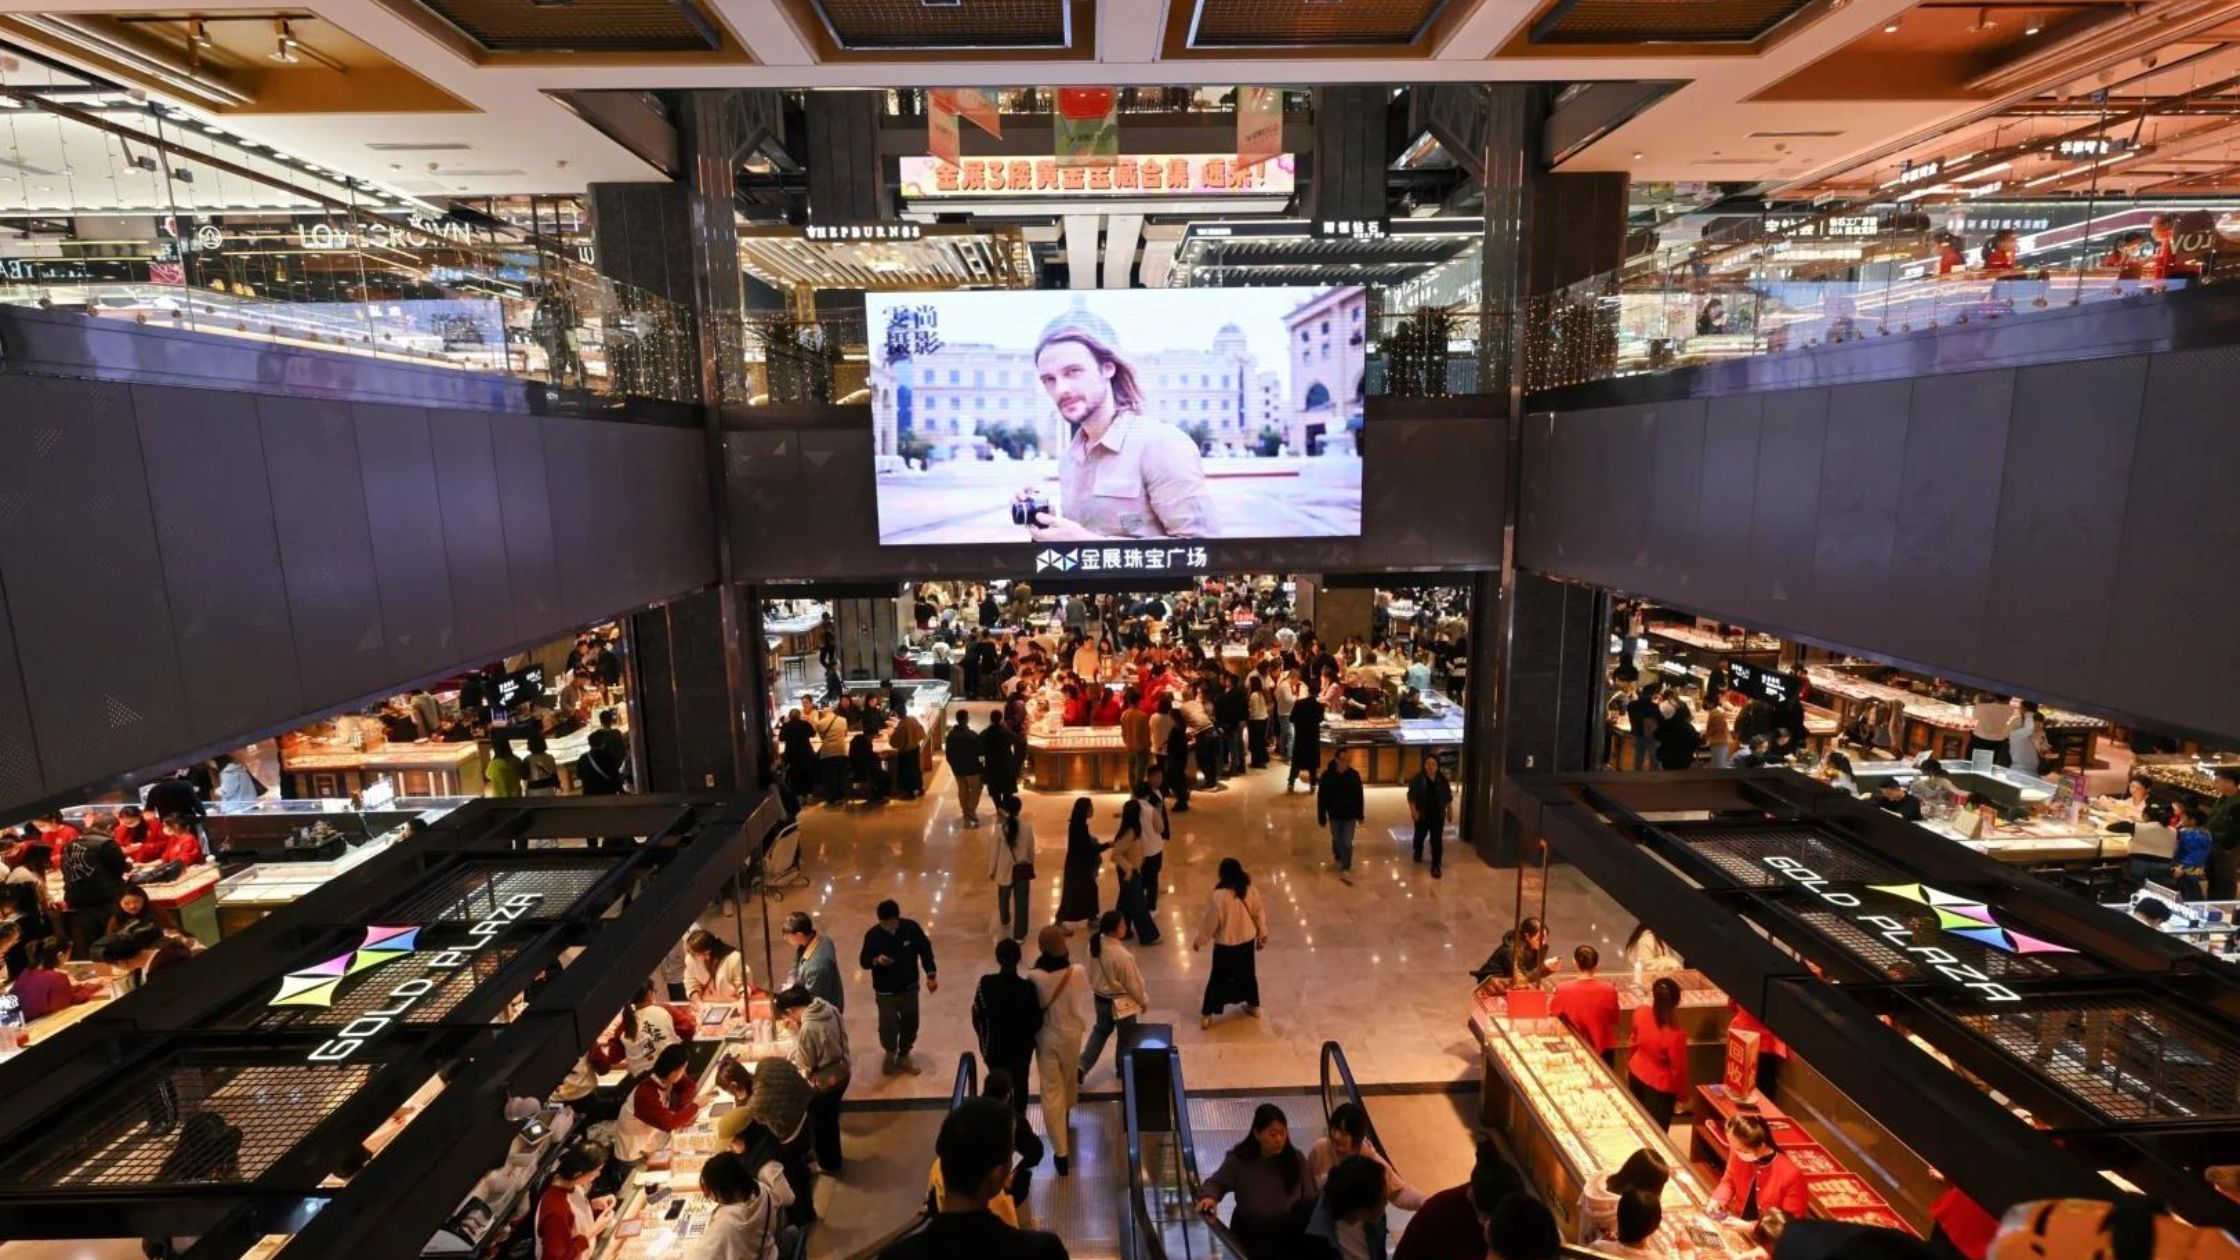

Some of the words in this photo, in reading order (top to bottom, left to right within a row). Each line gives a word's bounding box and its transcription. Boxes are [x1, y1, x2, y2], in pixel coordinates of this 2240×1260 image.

[1080, 547, 1208, 570] 金展珠宝广场
[1763, 856, 1861, 907] GOLD
[1857, 916, 2022, 1001] PLAZA
[308, 979, 434, 1060] GOLD
[428, 894, 544, 967] PLAZA
[1728, 1040, 1744, 1088] 回收
